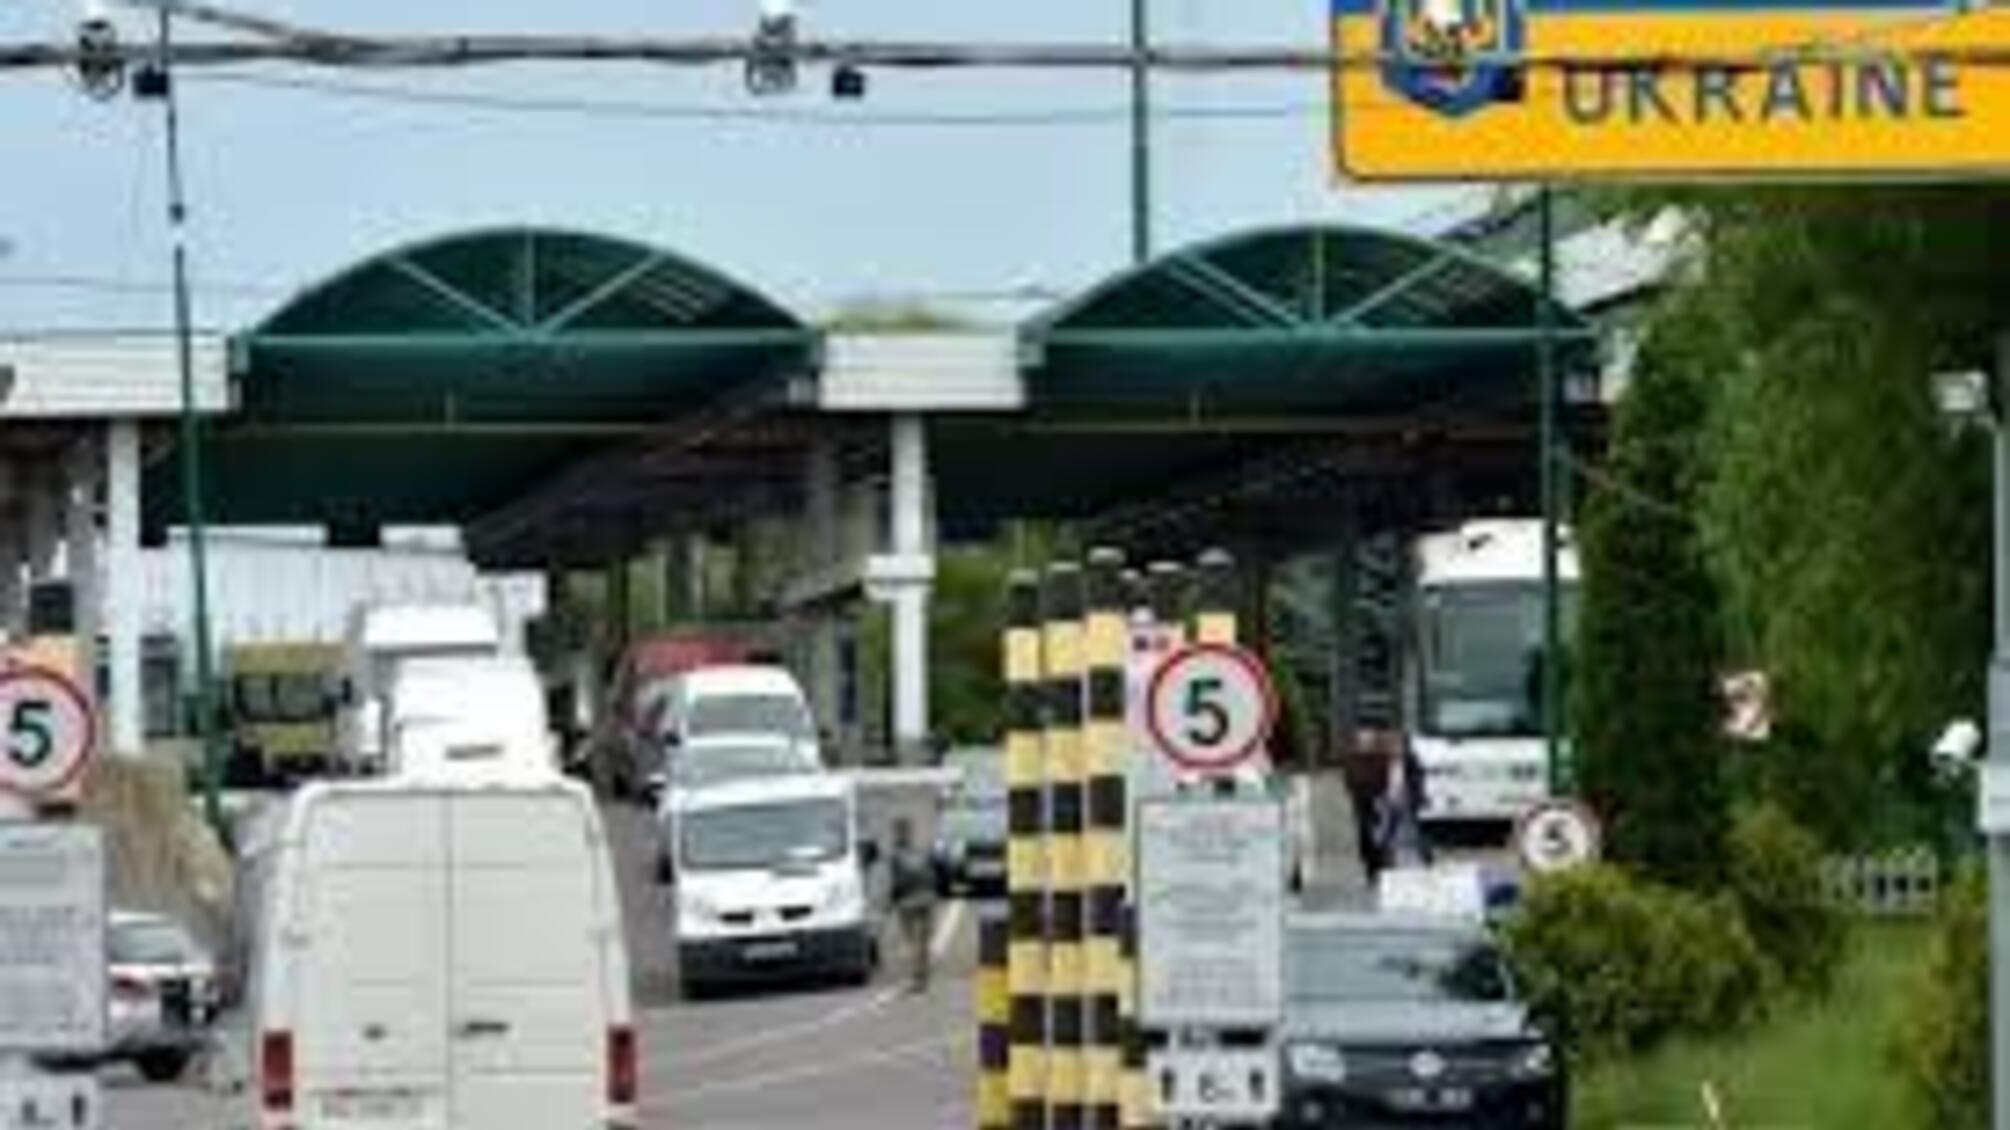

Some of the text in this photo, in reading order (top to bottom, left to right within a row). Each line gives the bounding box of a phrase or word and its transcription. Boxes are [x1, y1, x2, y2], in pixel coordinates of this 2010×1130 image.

[1561, 53, 1967, 124] UKRAINE
[9, 701, 52, 768] 5
[1184, 679, 1228, 747] 5
[1540, 820, 1572, 858] 5
